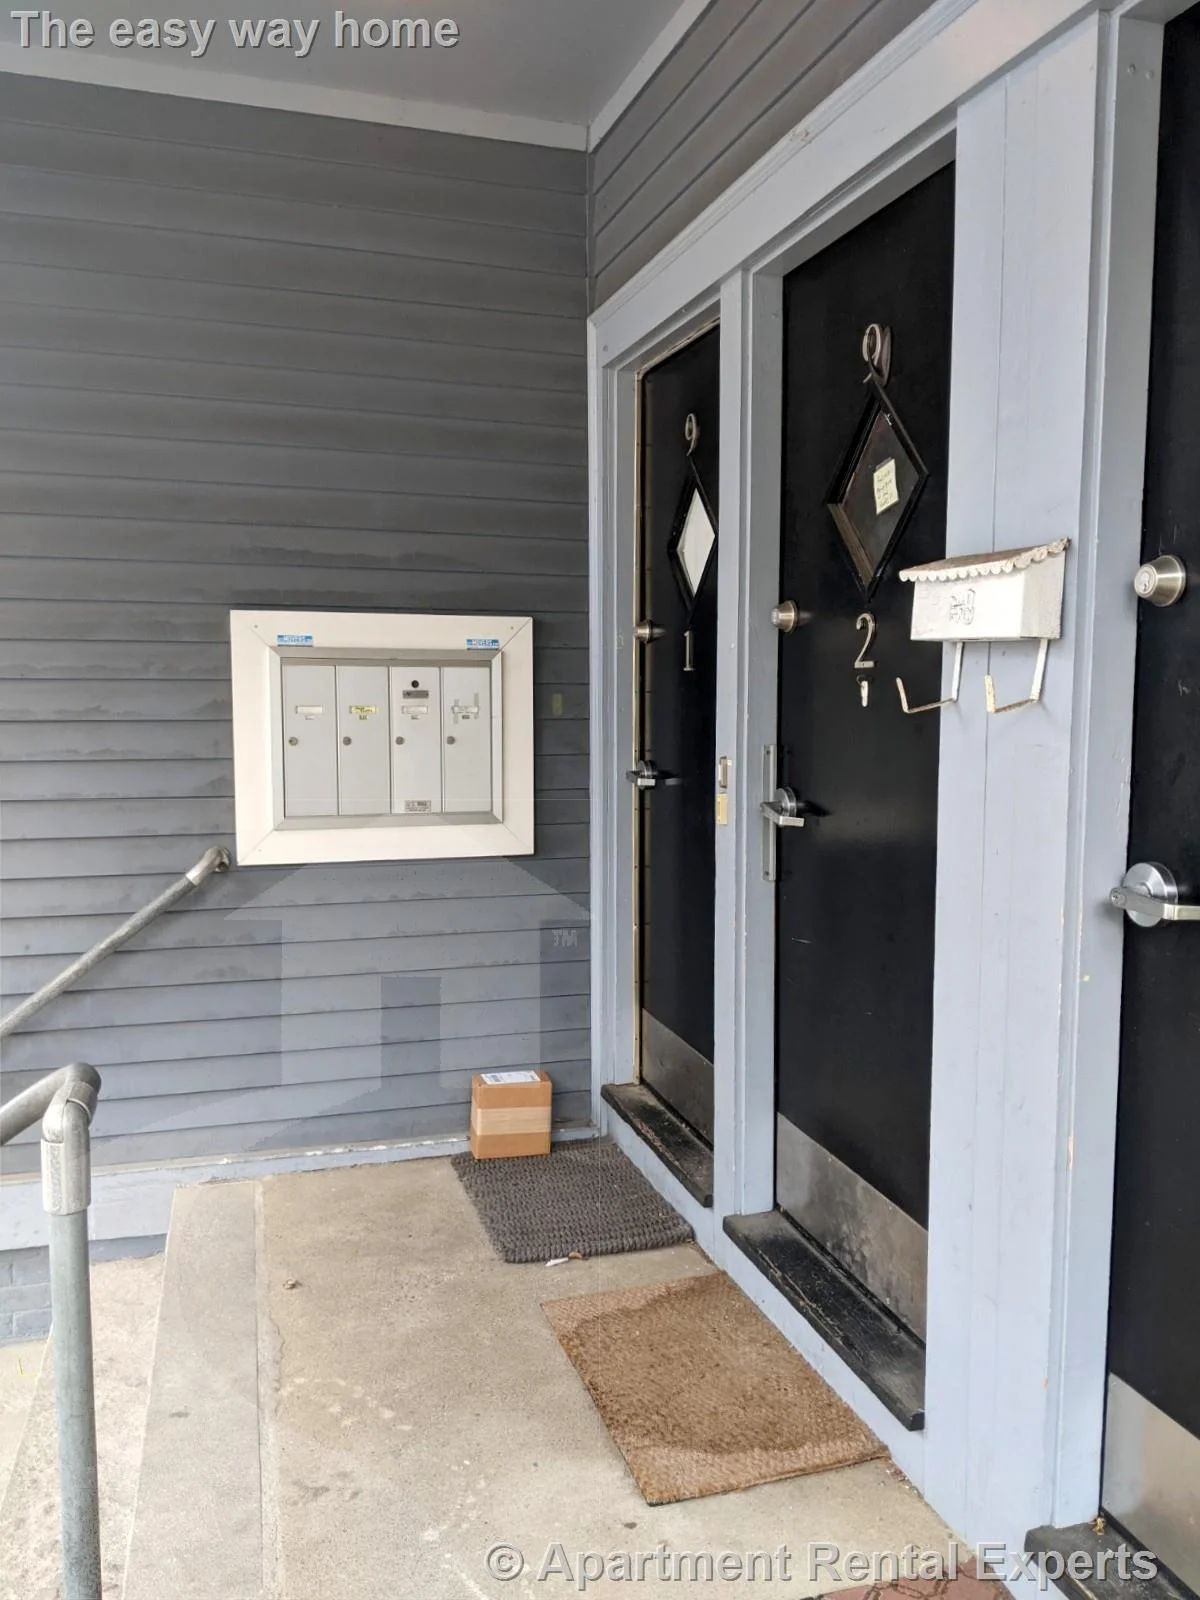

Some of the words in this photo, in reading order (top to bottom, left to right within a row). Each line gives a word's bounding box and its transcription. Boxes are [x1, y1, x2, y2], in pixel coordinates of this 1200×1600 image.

[684, 413, 698, 457] 9
[683, 630, 696, 671] 1
[854, 613, 875, 669] 2
